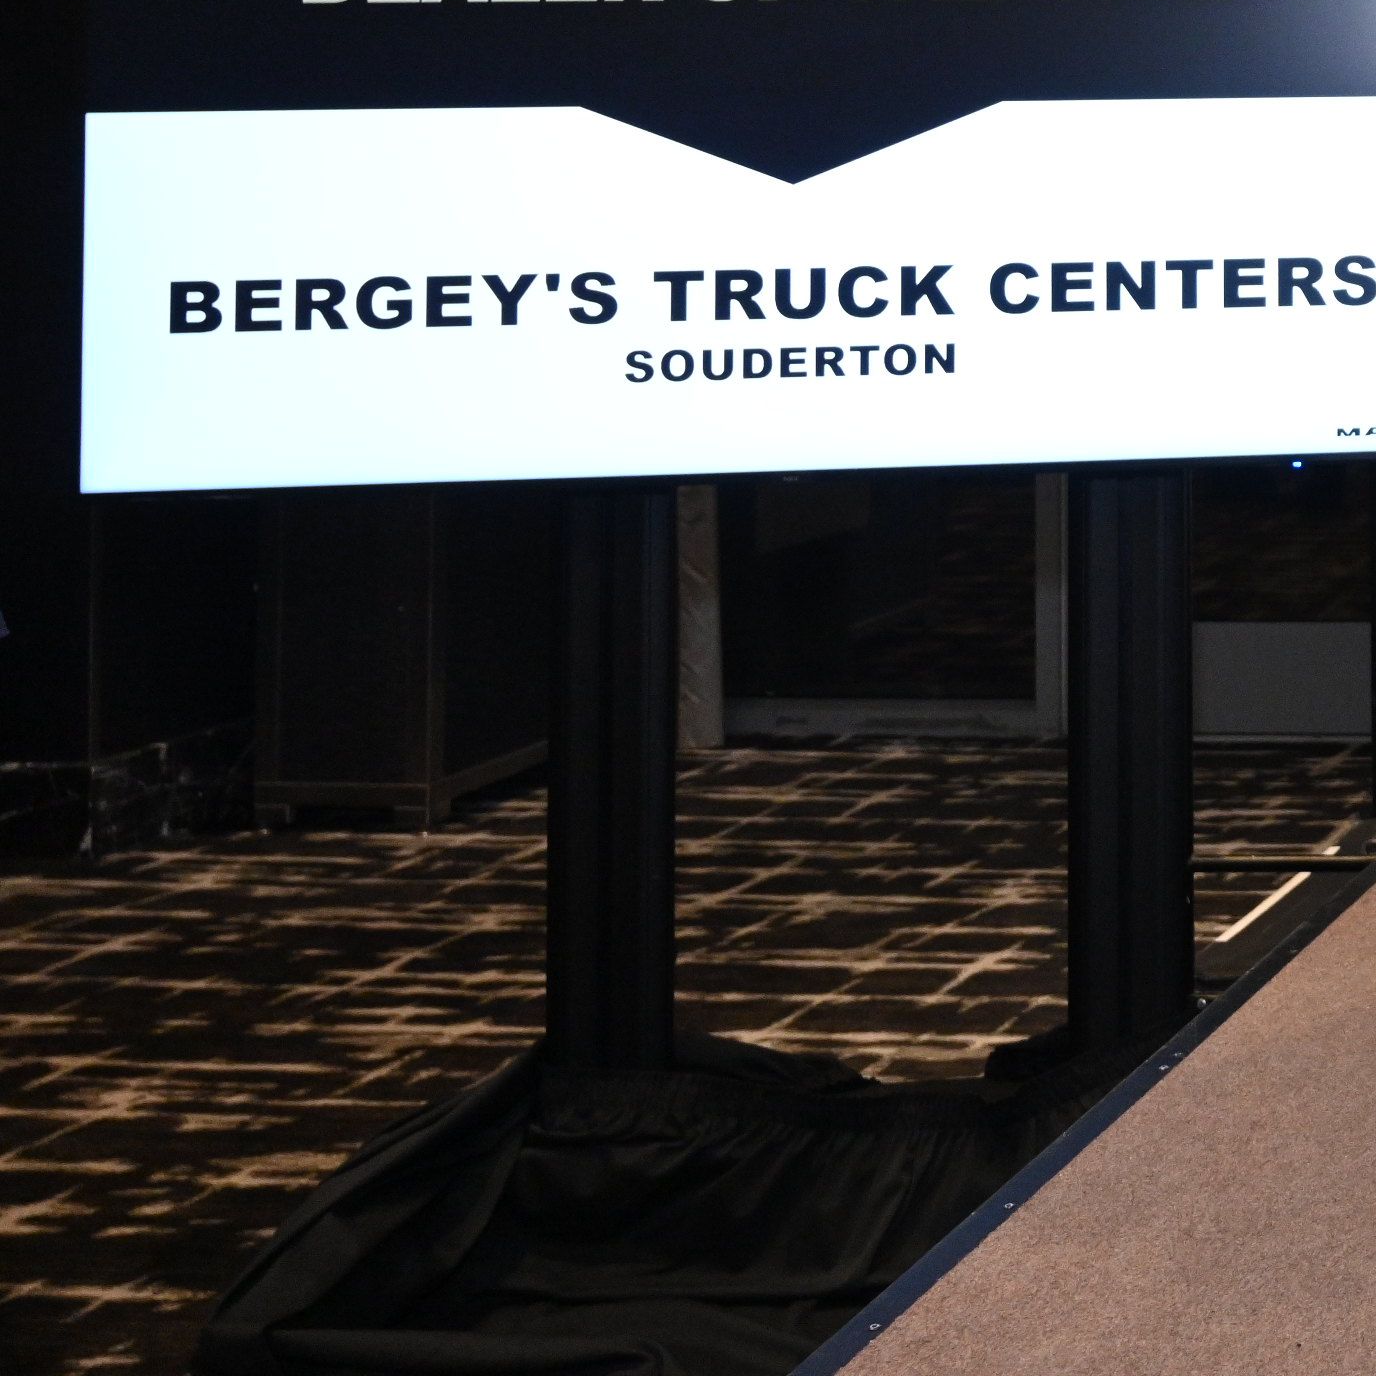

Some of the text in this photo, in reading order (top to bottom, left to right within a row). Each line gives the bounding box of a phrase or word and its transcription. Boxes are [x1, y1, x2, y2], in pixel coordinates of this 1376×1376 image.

[170, 256, 1376, 333] BERGEY'S TRUCK CENTERS
[626, 344, 954, 382] SOUDERTON
